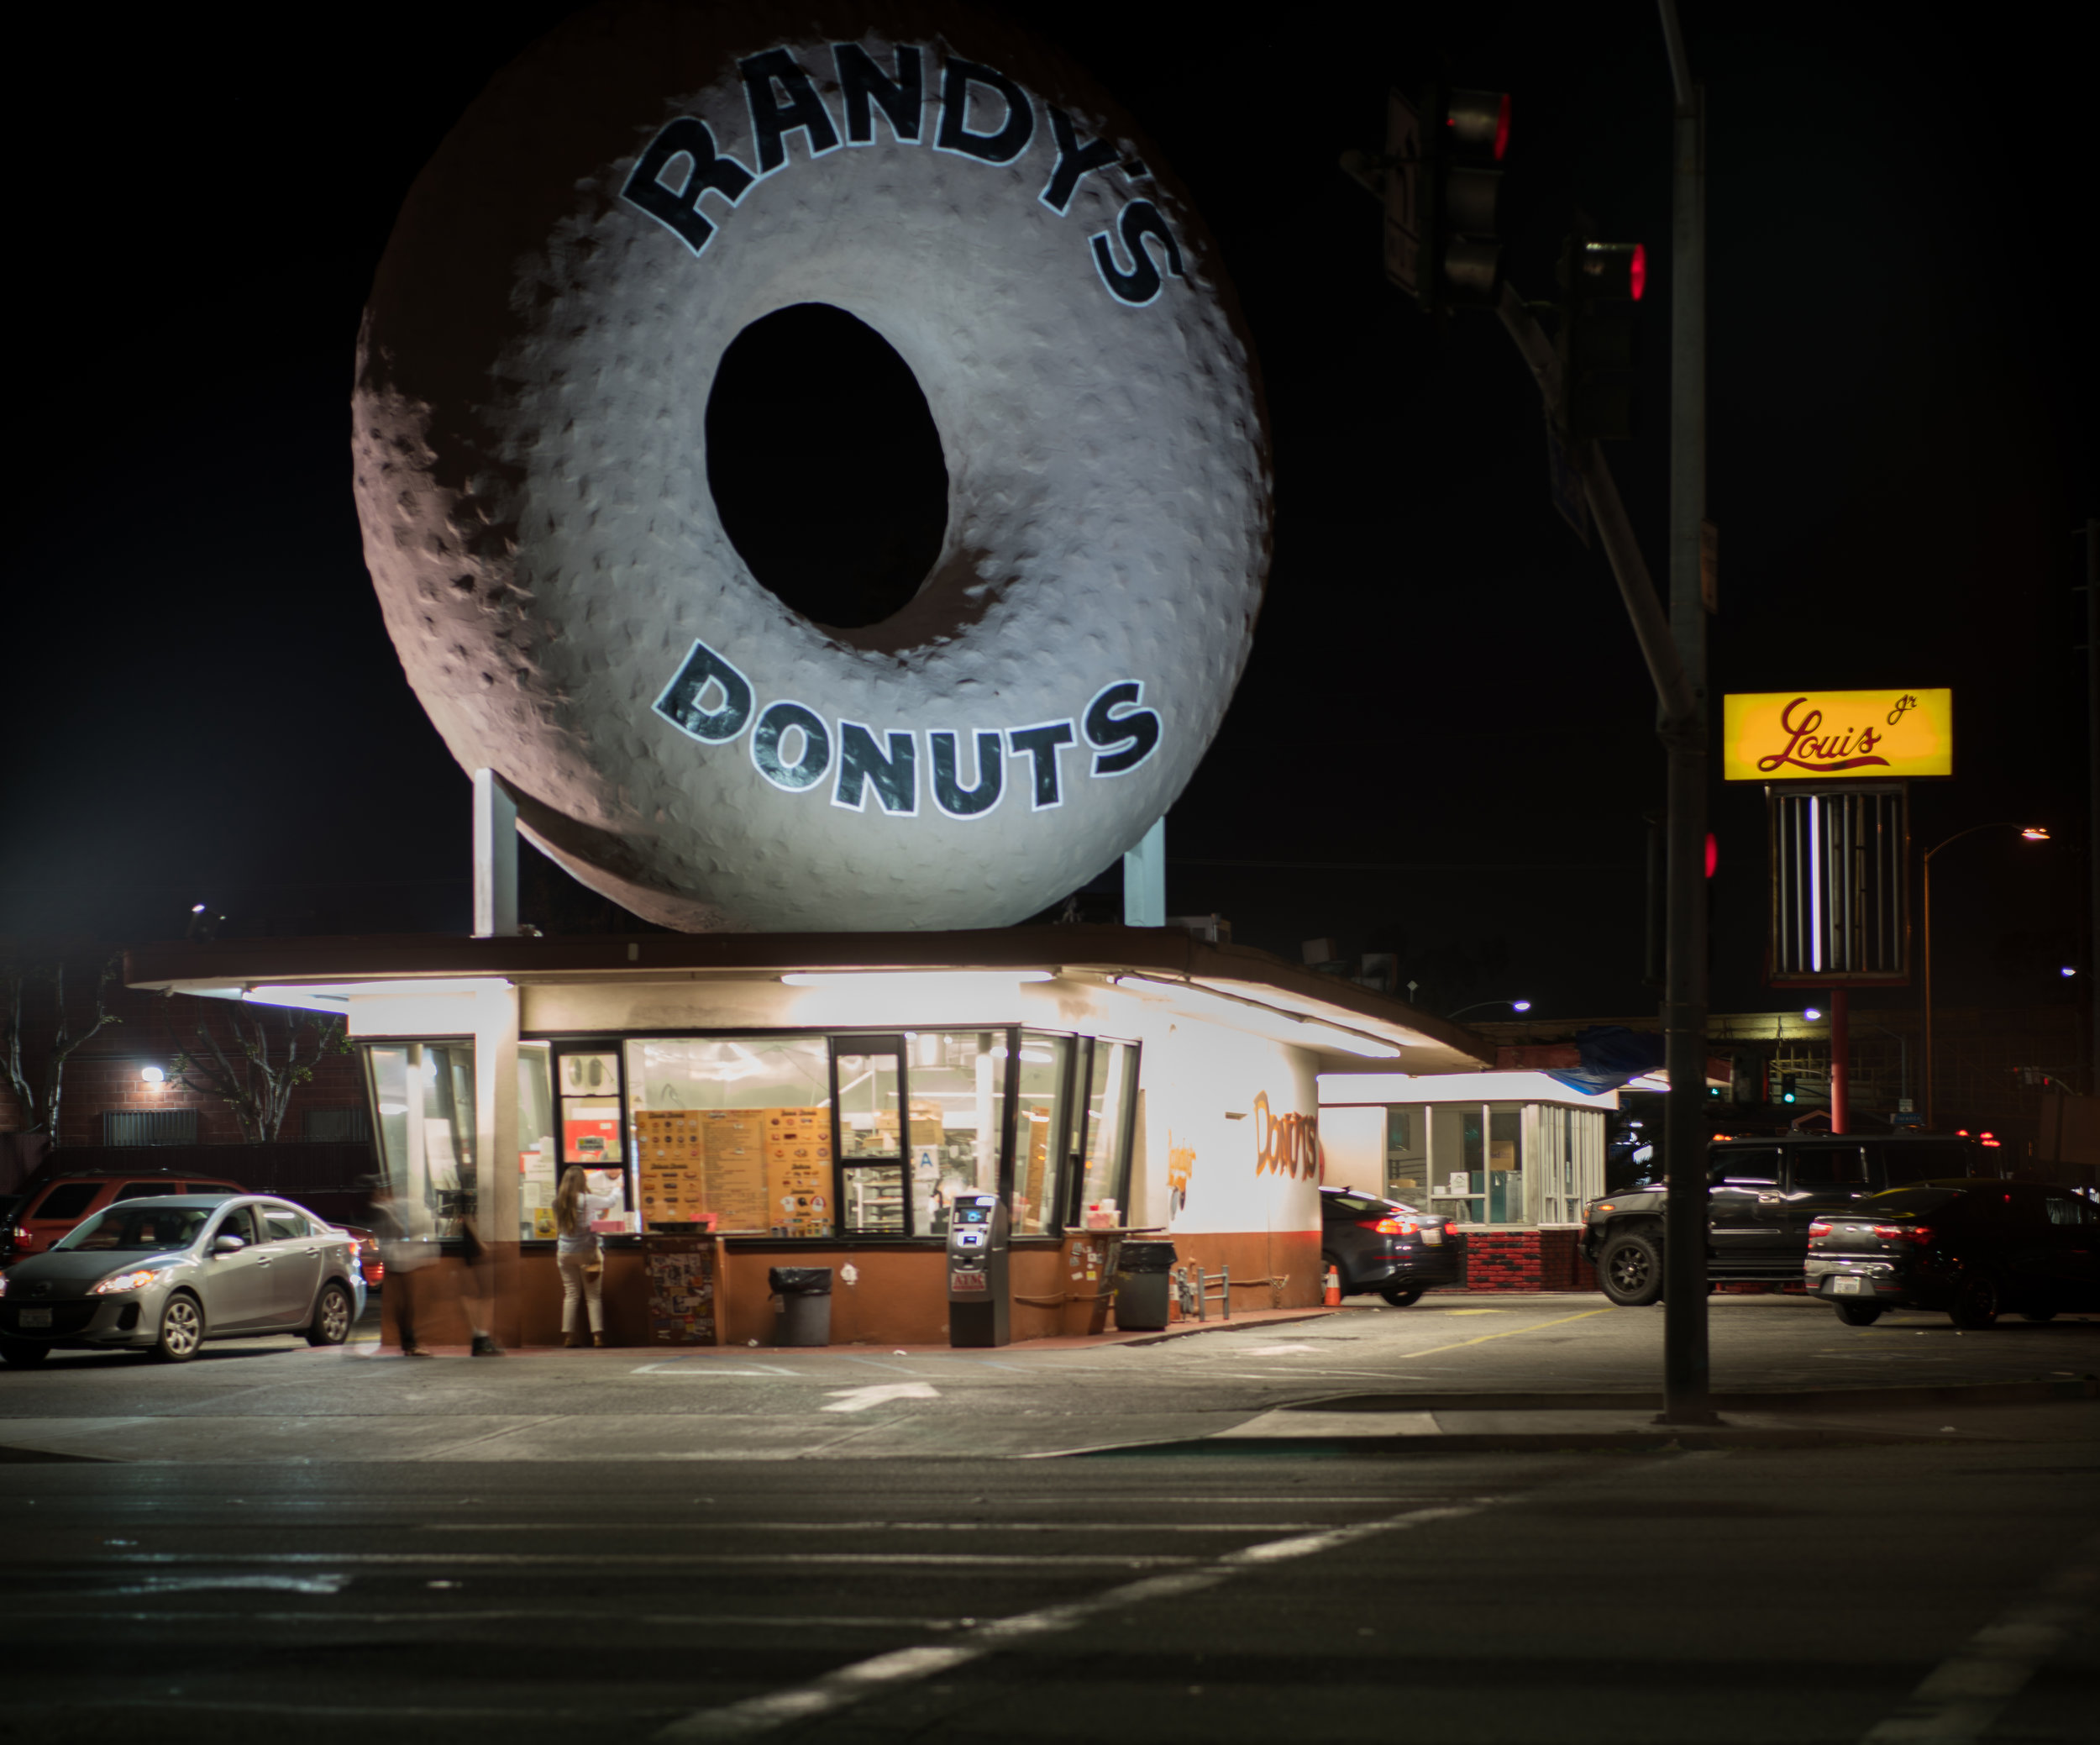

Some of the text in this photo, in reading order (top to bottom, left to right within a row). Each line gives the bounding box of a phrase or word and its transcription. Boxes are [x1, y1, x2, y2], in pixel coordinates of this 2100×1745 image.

[620, 42, 1185, 307] RANDY'S
[651, 639, 1163, 820] DONUTS
[1756, 697, 1891, 772] Louis
[920, 1152, 933, 1168] A
[954, 1274, 983, 1285] ATM
